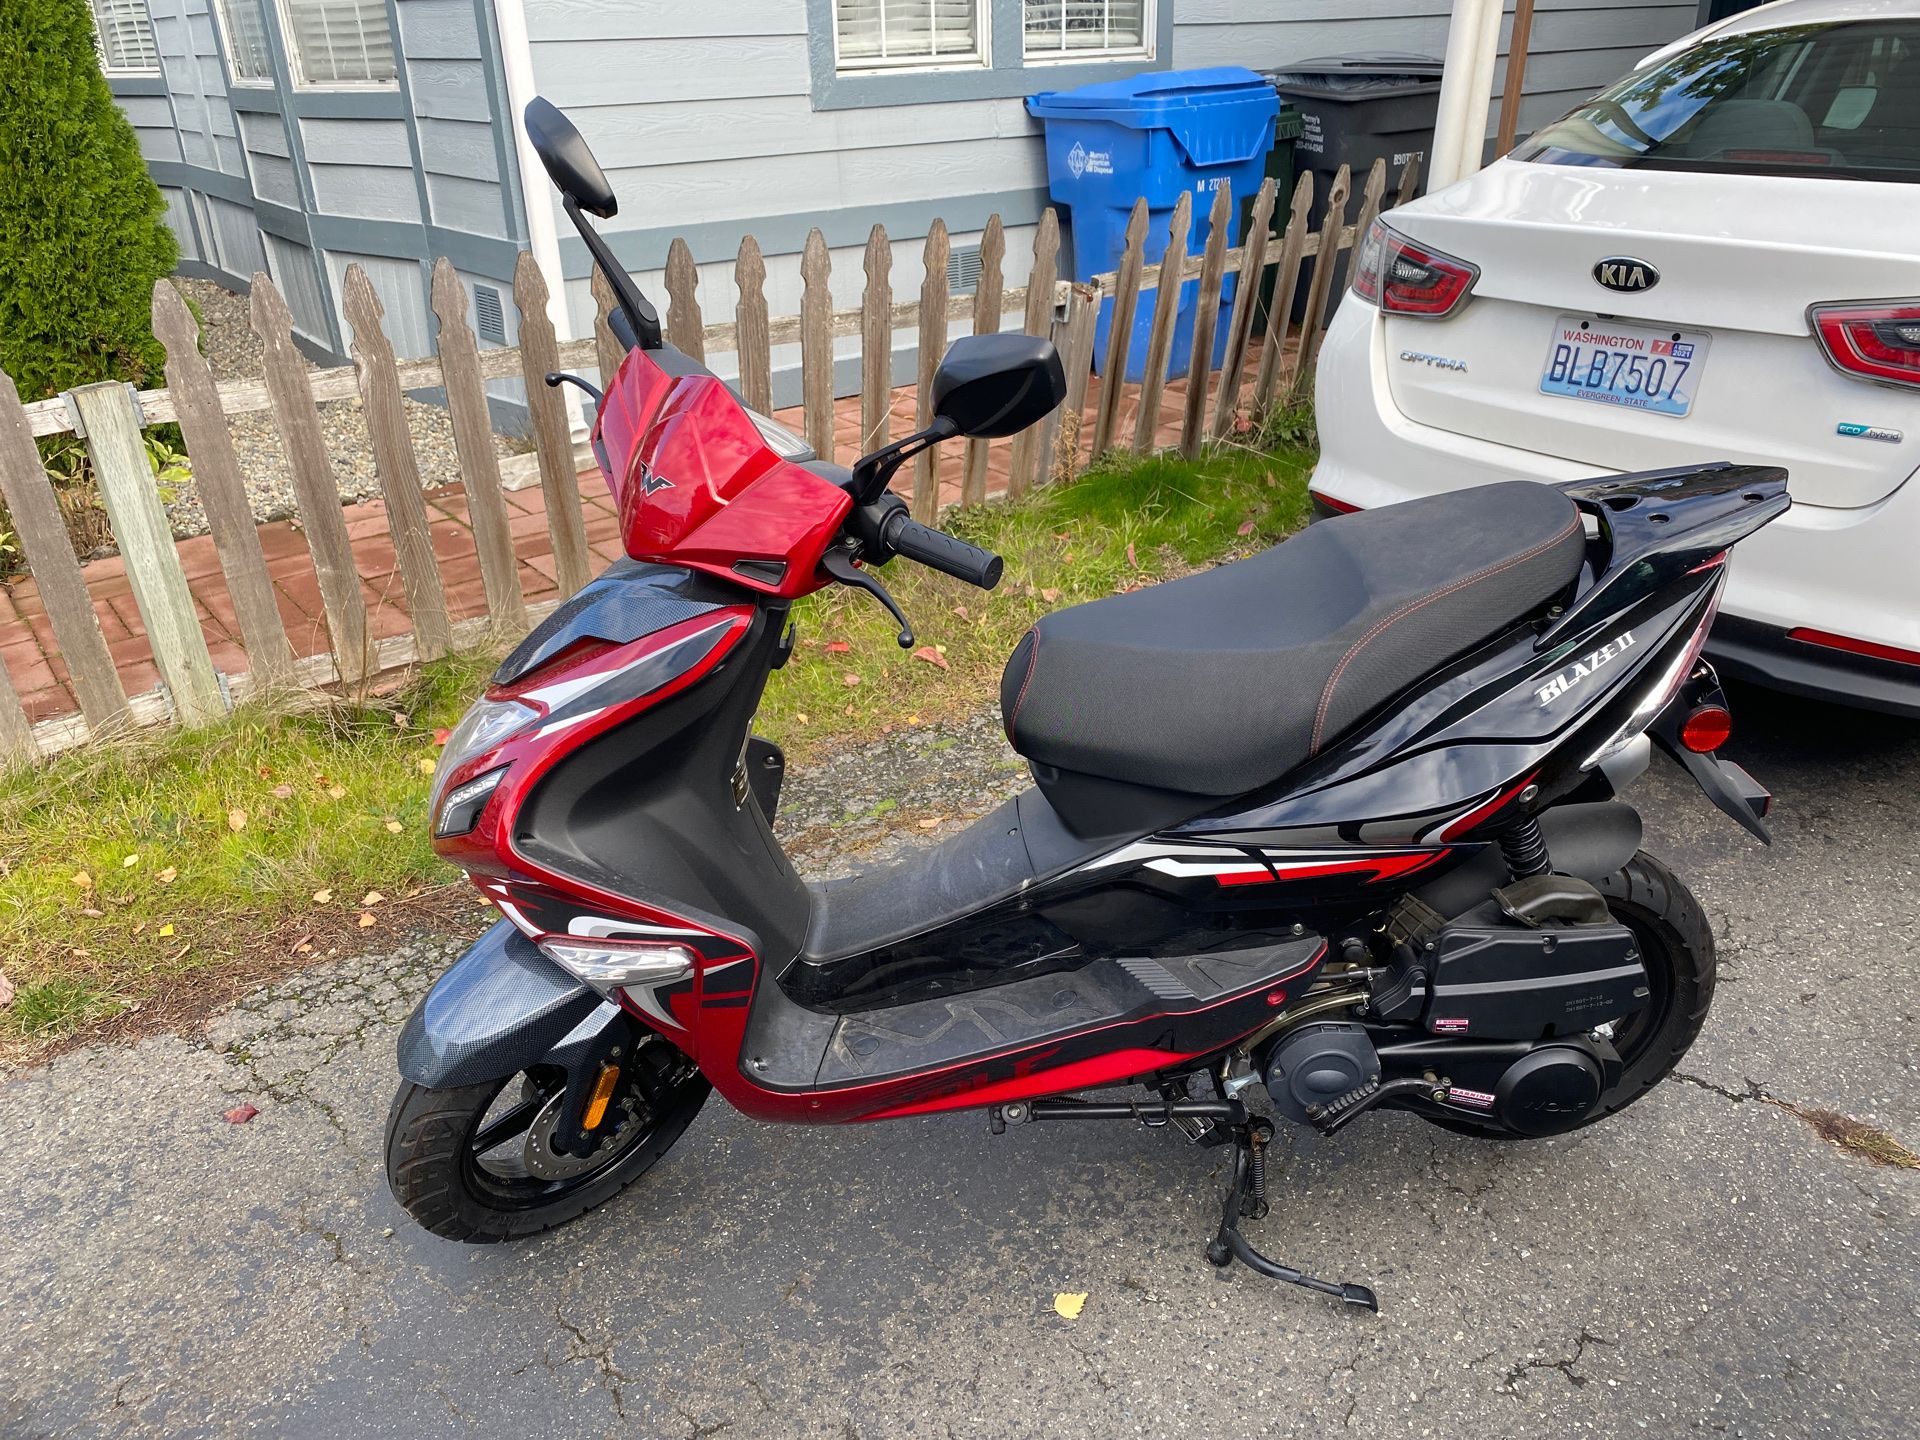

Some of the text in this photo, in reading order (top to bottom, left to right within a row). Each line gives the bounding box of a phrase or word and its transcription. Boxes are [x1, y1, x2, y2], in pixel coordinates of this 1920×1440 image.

[1197, 179, 1205, 192] M
[1601, 263, 1646, 288] KIA
[1562, 329, 1644, 350] WASHINGTON
[1657, 341, 1666, 352] 7
[1400, 351, 1469, 373] OPTIMA
[1672, 349, 1691, 358] 2021
[1549, 344, 1691, 400] BLB7507
[1576, 389, 1649, 408] EVERGREEN STATE
[1868, 429, 1899, 441] hybrid
[1534, 643, 1620, 707] BLAZE
[1450, 1088, 1493, 1101] WARNING
